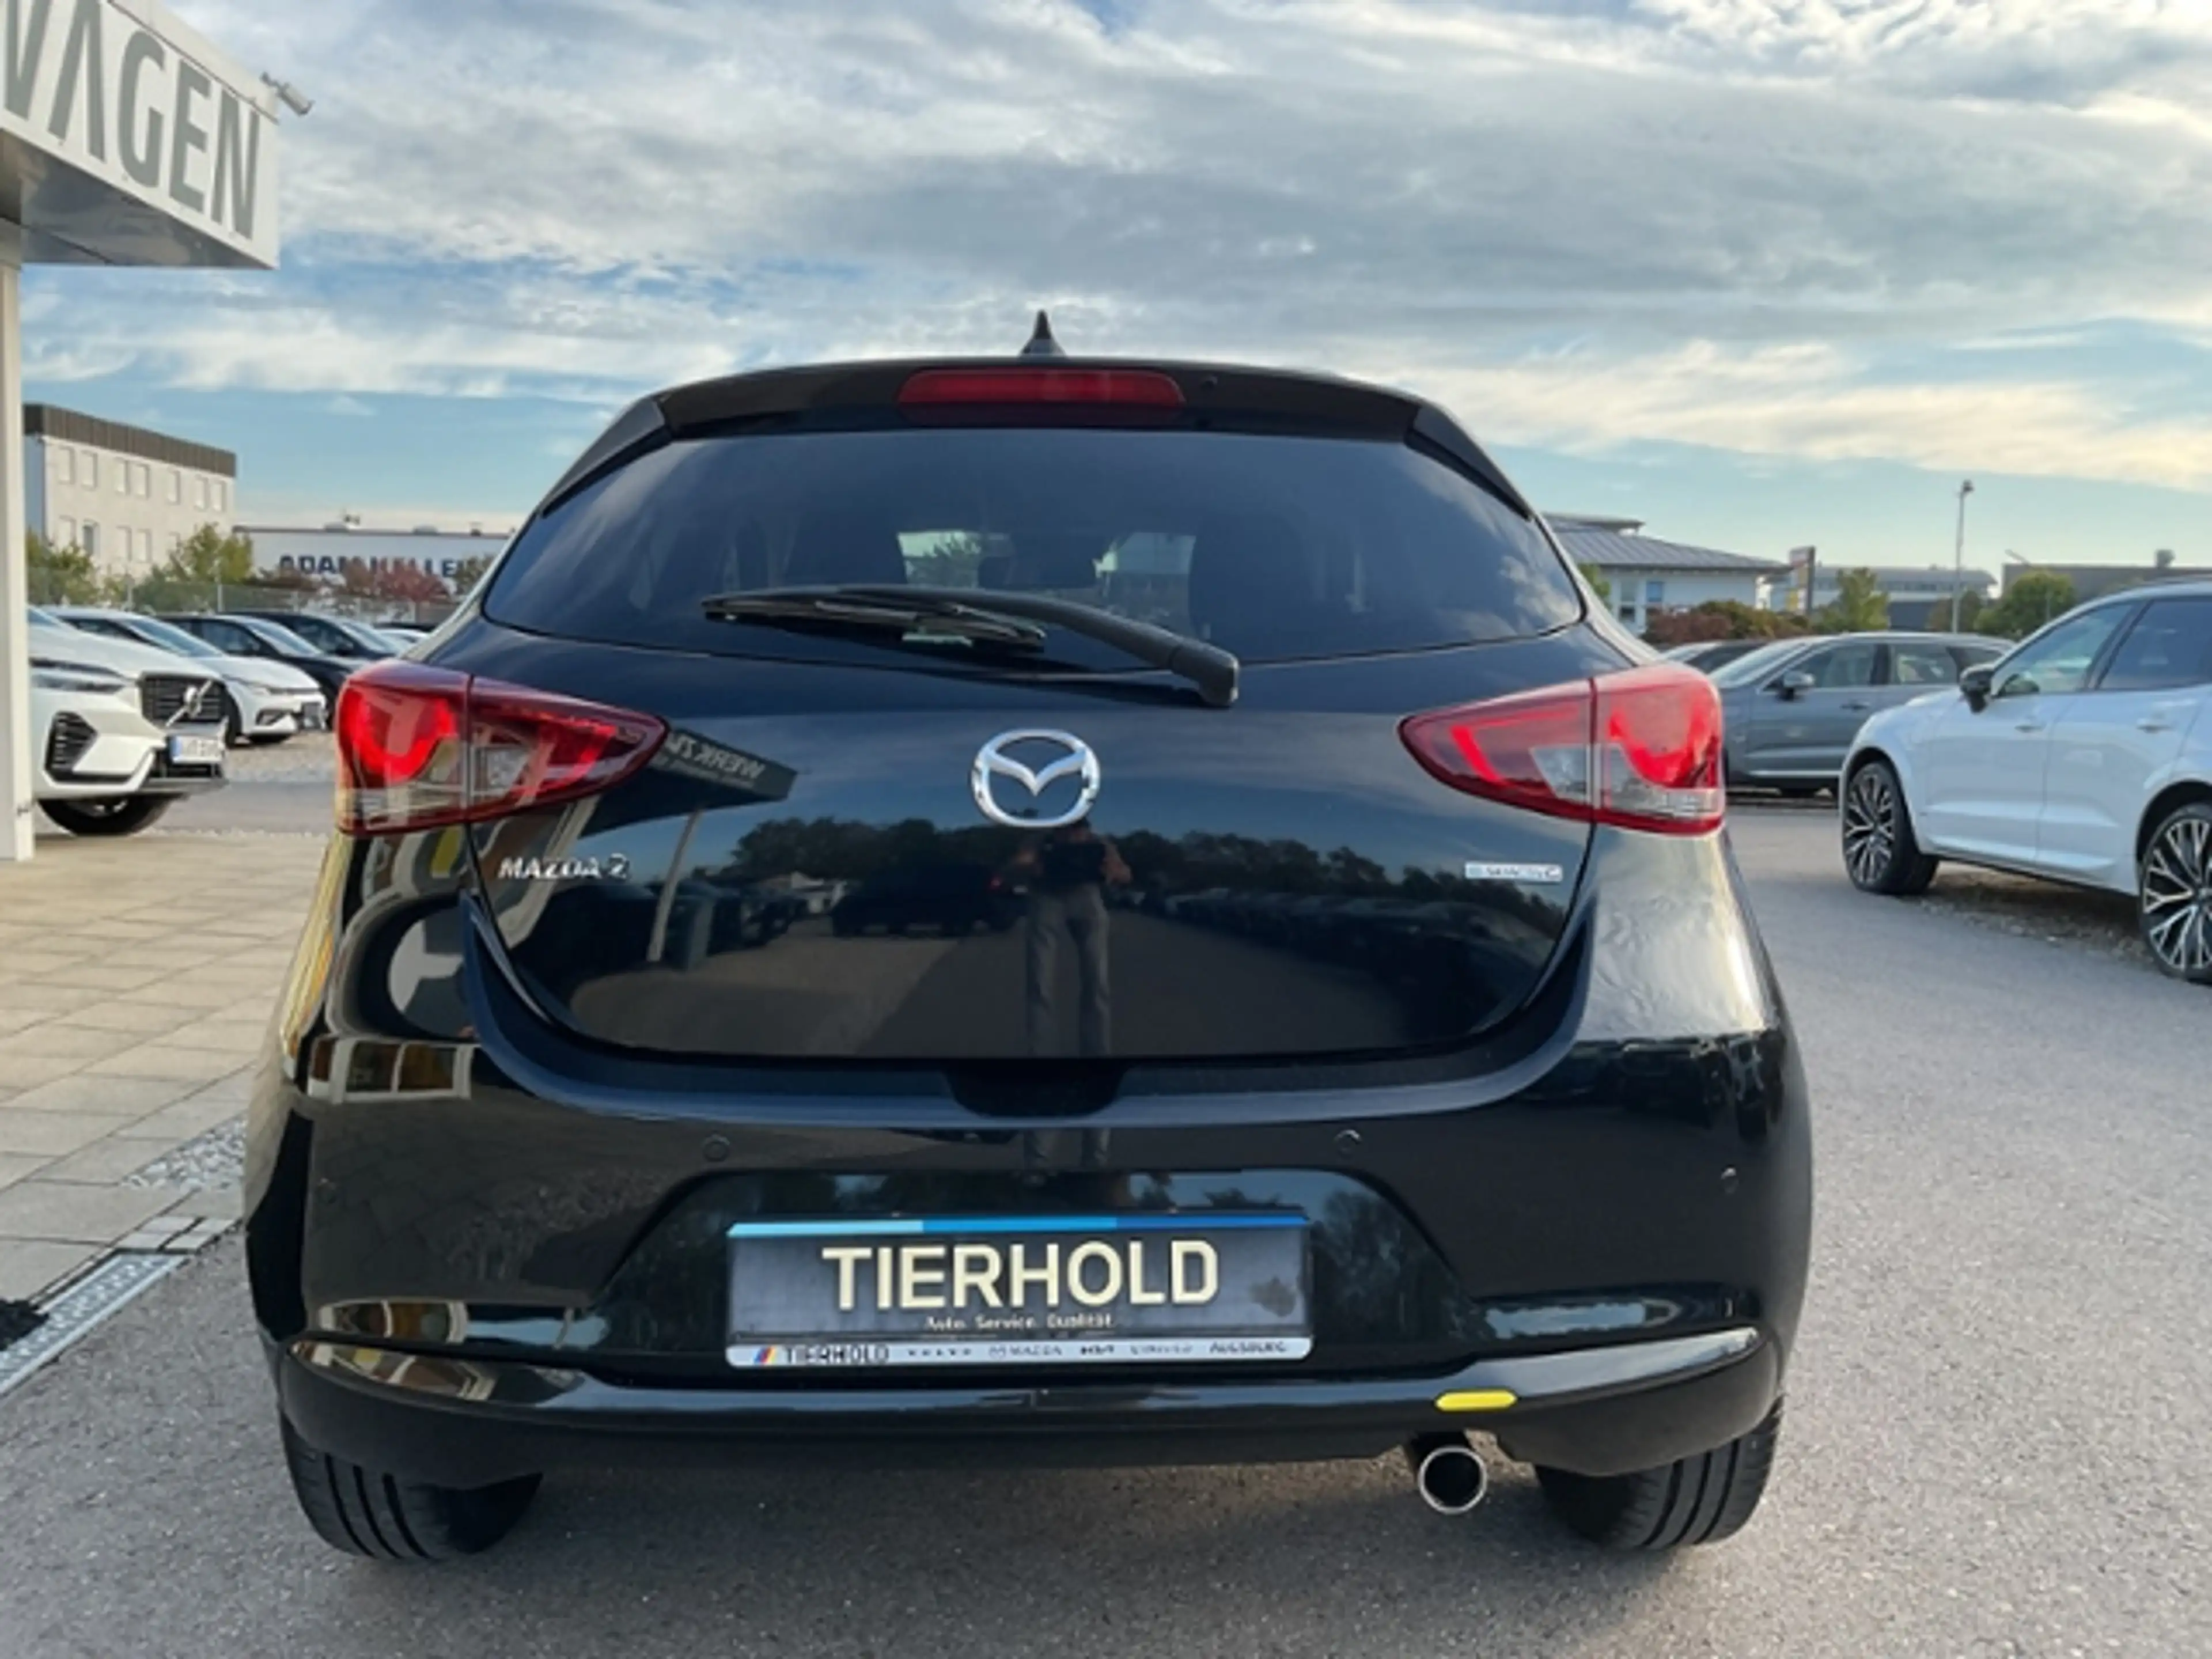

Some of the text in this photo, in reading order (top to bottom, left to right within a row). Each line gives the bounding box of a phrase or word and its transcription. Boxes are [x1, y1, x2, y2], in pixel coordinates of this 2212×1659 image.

[498, 853, 628, 879] MAZDA 2
[821, 1240, 1218, 1310] TIERHOLD
[785, 1344, 889, 1365] TIERHOLD
